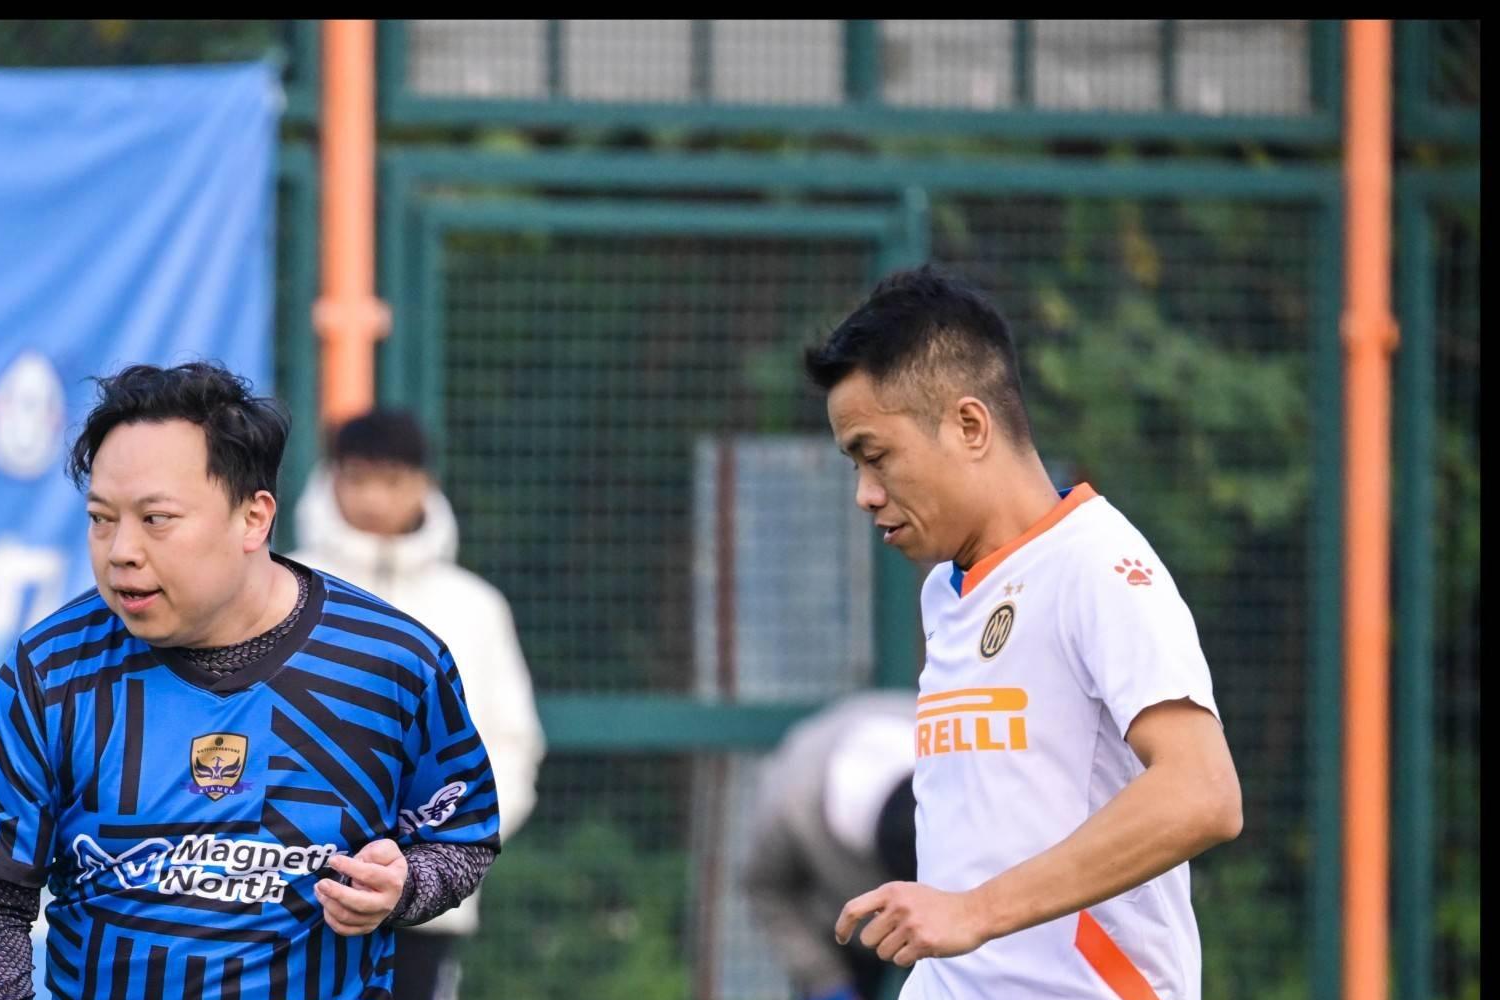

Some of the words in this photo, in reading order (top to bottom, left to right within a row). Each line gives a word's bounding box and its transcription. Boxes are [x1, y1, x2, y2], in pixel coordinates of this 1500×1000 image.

[916, 716, 1028, 758] RELLI
[198, 785, 235, 795] XIAMEN
[175, 838, 346, 874] Magneti
[163, 868, 283, 899] North
